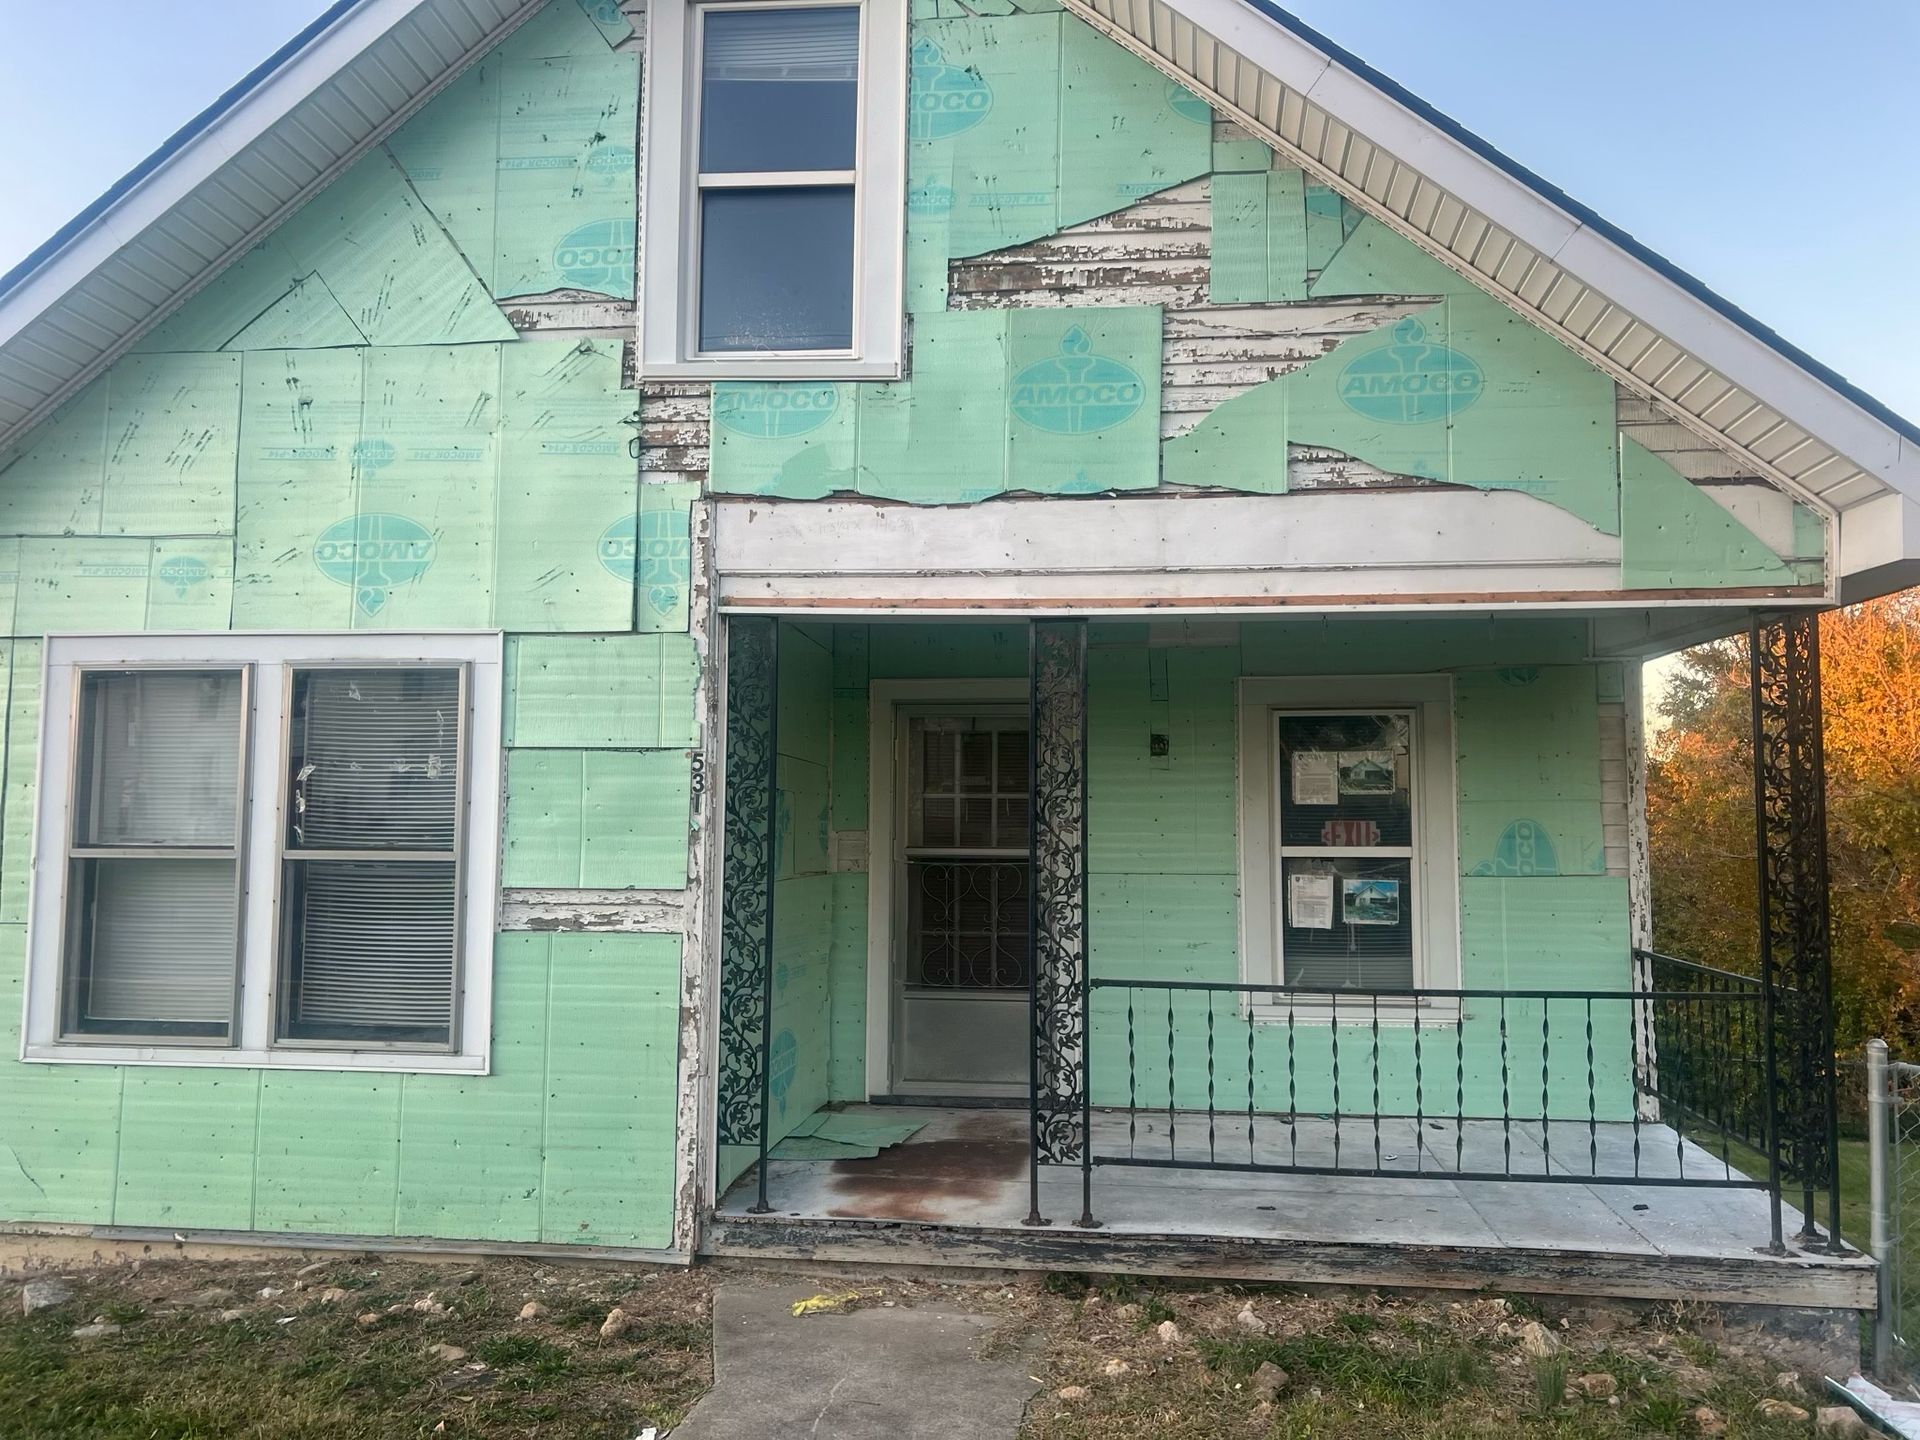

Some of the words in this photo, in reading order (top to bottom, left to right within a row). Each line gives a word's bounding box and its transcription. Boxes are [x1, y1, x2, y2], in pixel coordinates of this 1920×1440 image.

[911, 92, 989, 111] OCO
[1343, 372, 1480, 395] AMOCO
[713, 390, 834, 410] AMOCO
[1010, 384, 1142, 405] AMOCO
[316, 542, 434, 561] AMOCO
[692, 752, 705, 814] 531
